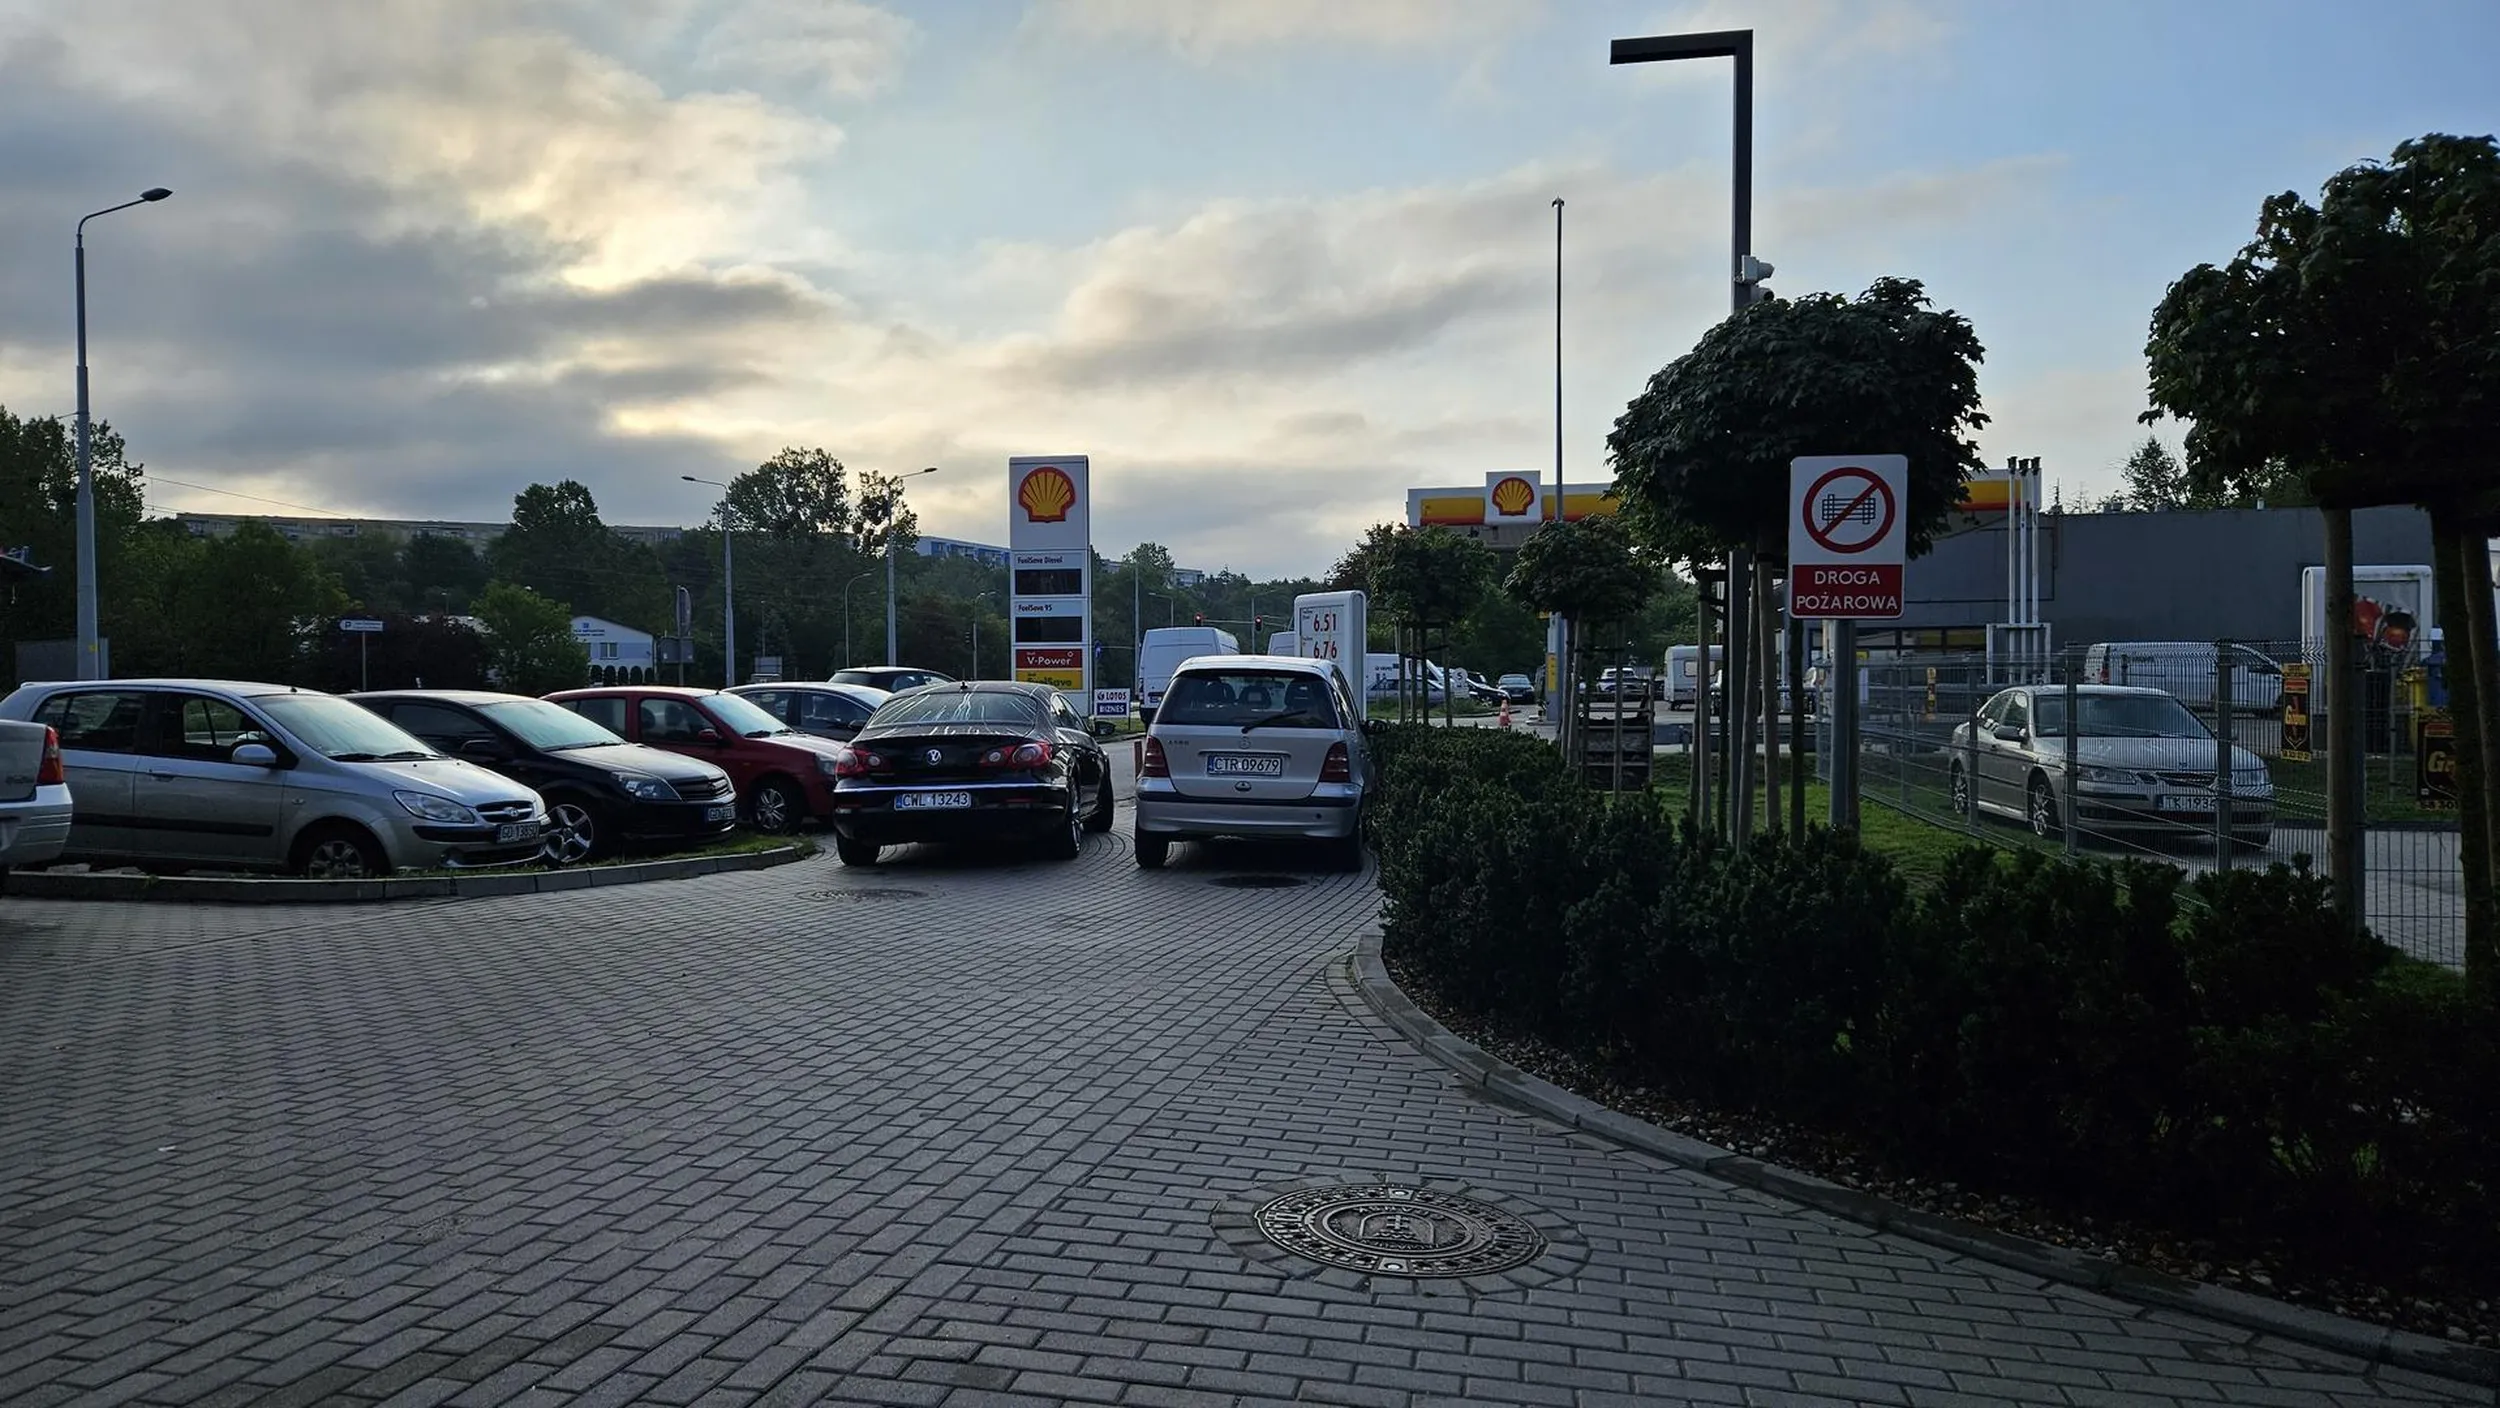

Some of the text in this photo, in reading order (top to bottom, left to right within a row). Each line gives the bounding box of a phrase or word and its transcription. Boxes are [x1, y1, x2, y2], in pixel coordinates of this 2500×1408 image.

[1814, 570, 1880, 585] DROGA
[1796, 591, 1898, 610] POŻAROWA
[1313, 613, 1337, 632] 6.51
[1313, 640, 1338, 659] 6.76
[1027, 656, 1071, 666] V-Power
[1105, 691, 1127, 700] LOTOS
[1099, 705, 1125, 713] BIZNES
[1215, 757, 1279, 772] CTR 09679
[902, 792, 968, 807] CWL 13243
